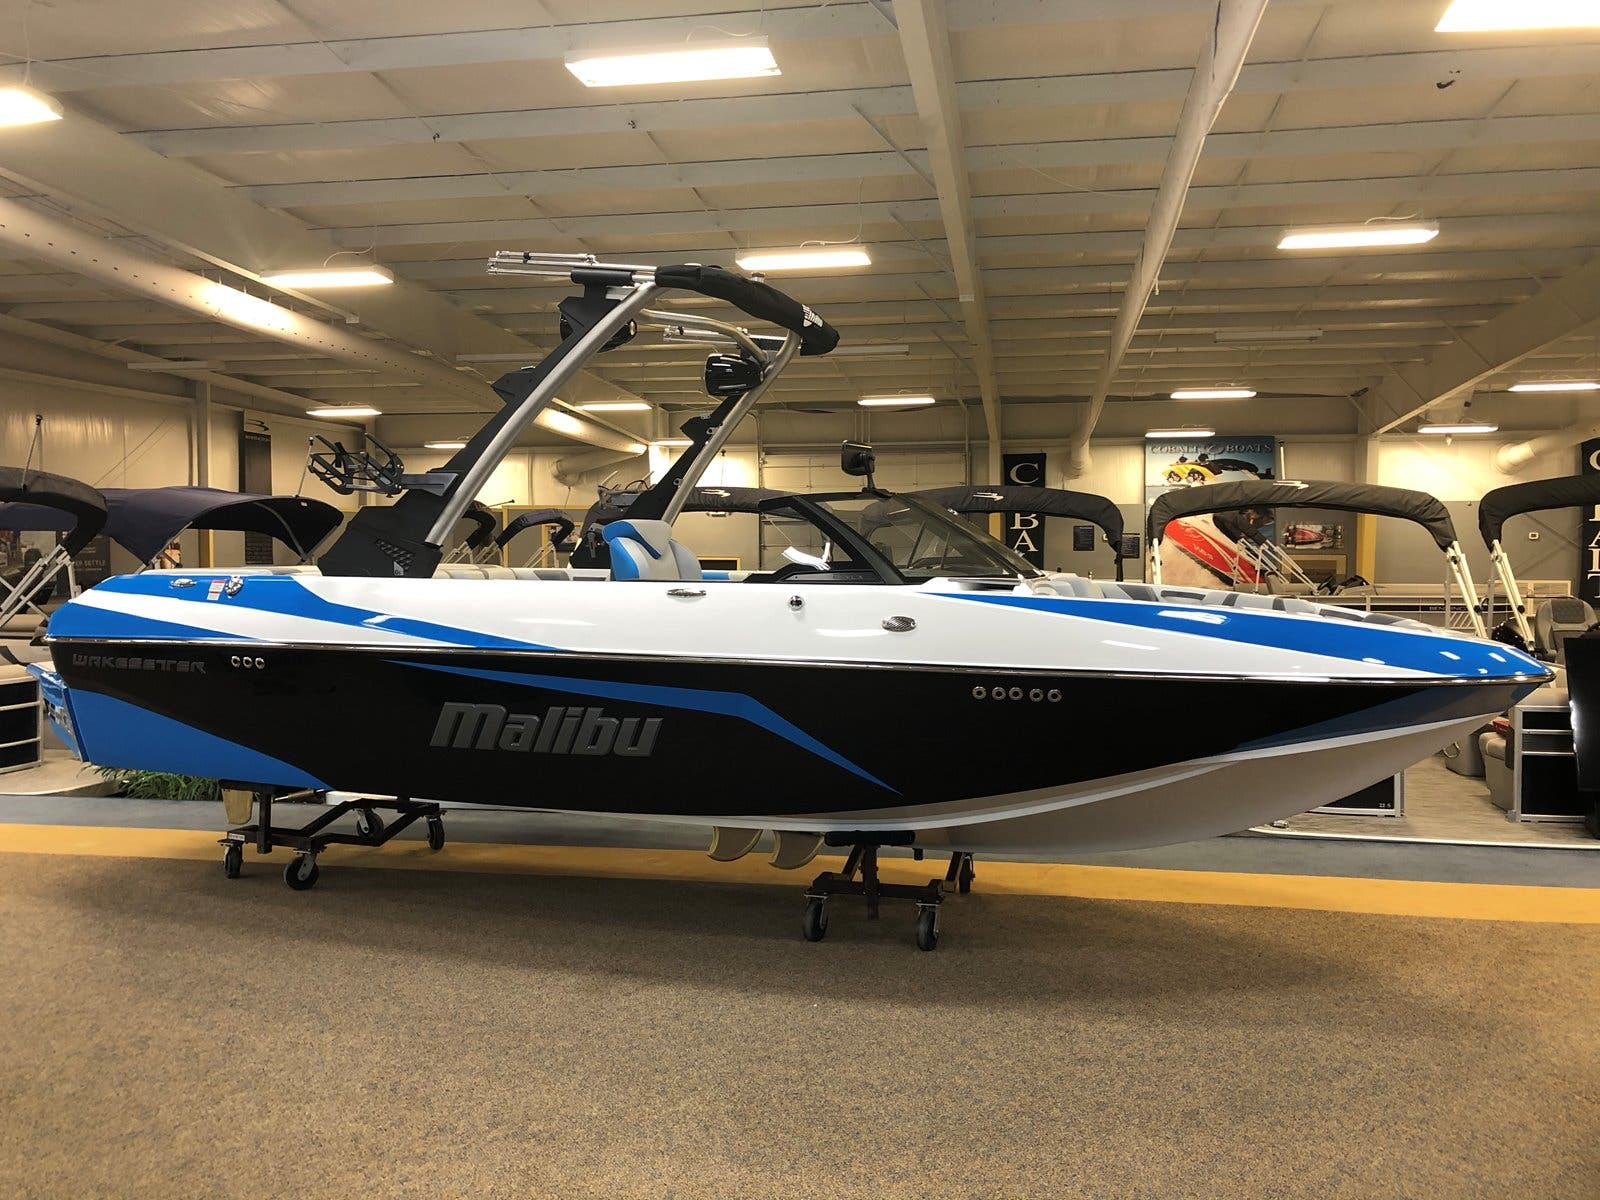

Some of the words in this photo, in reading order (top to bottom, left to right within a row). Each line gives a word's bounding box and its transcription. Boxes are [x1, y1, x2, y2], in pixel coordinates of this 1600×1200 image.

[1226, 444, 1272, 454] BOATS
[72, 653, 206, 674] WAKESETTER
[429, 701, 665, 757] Malibu
